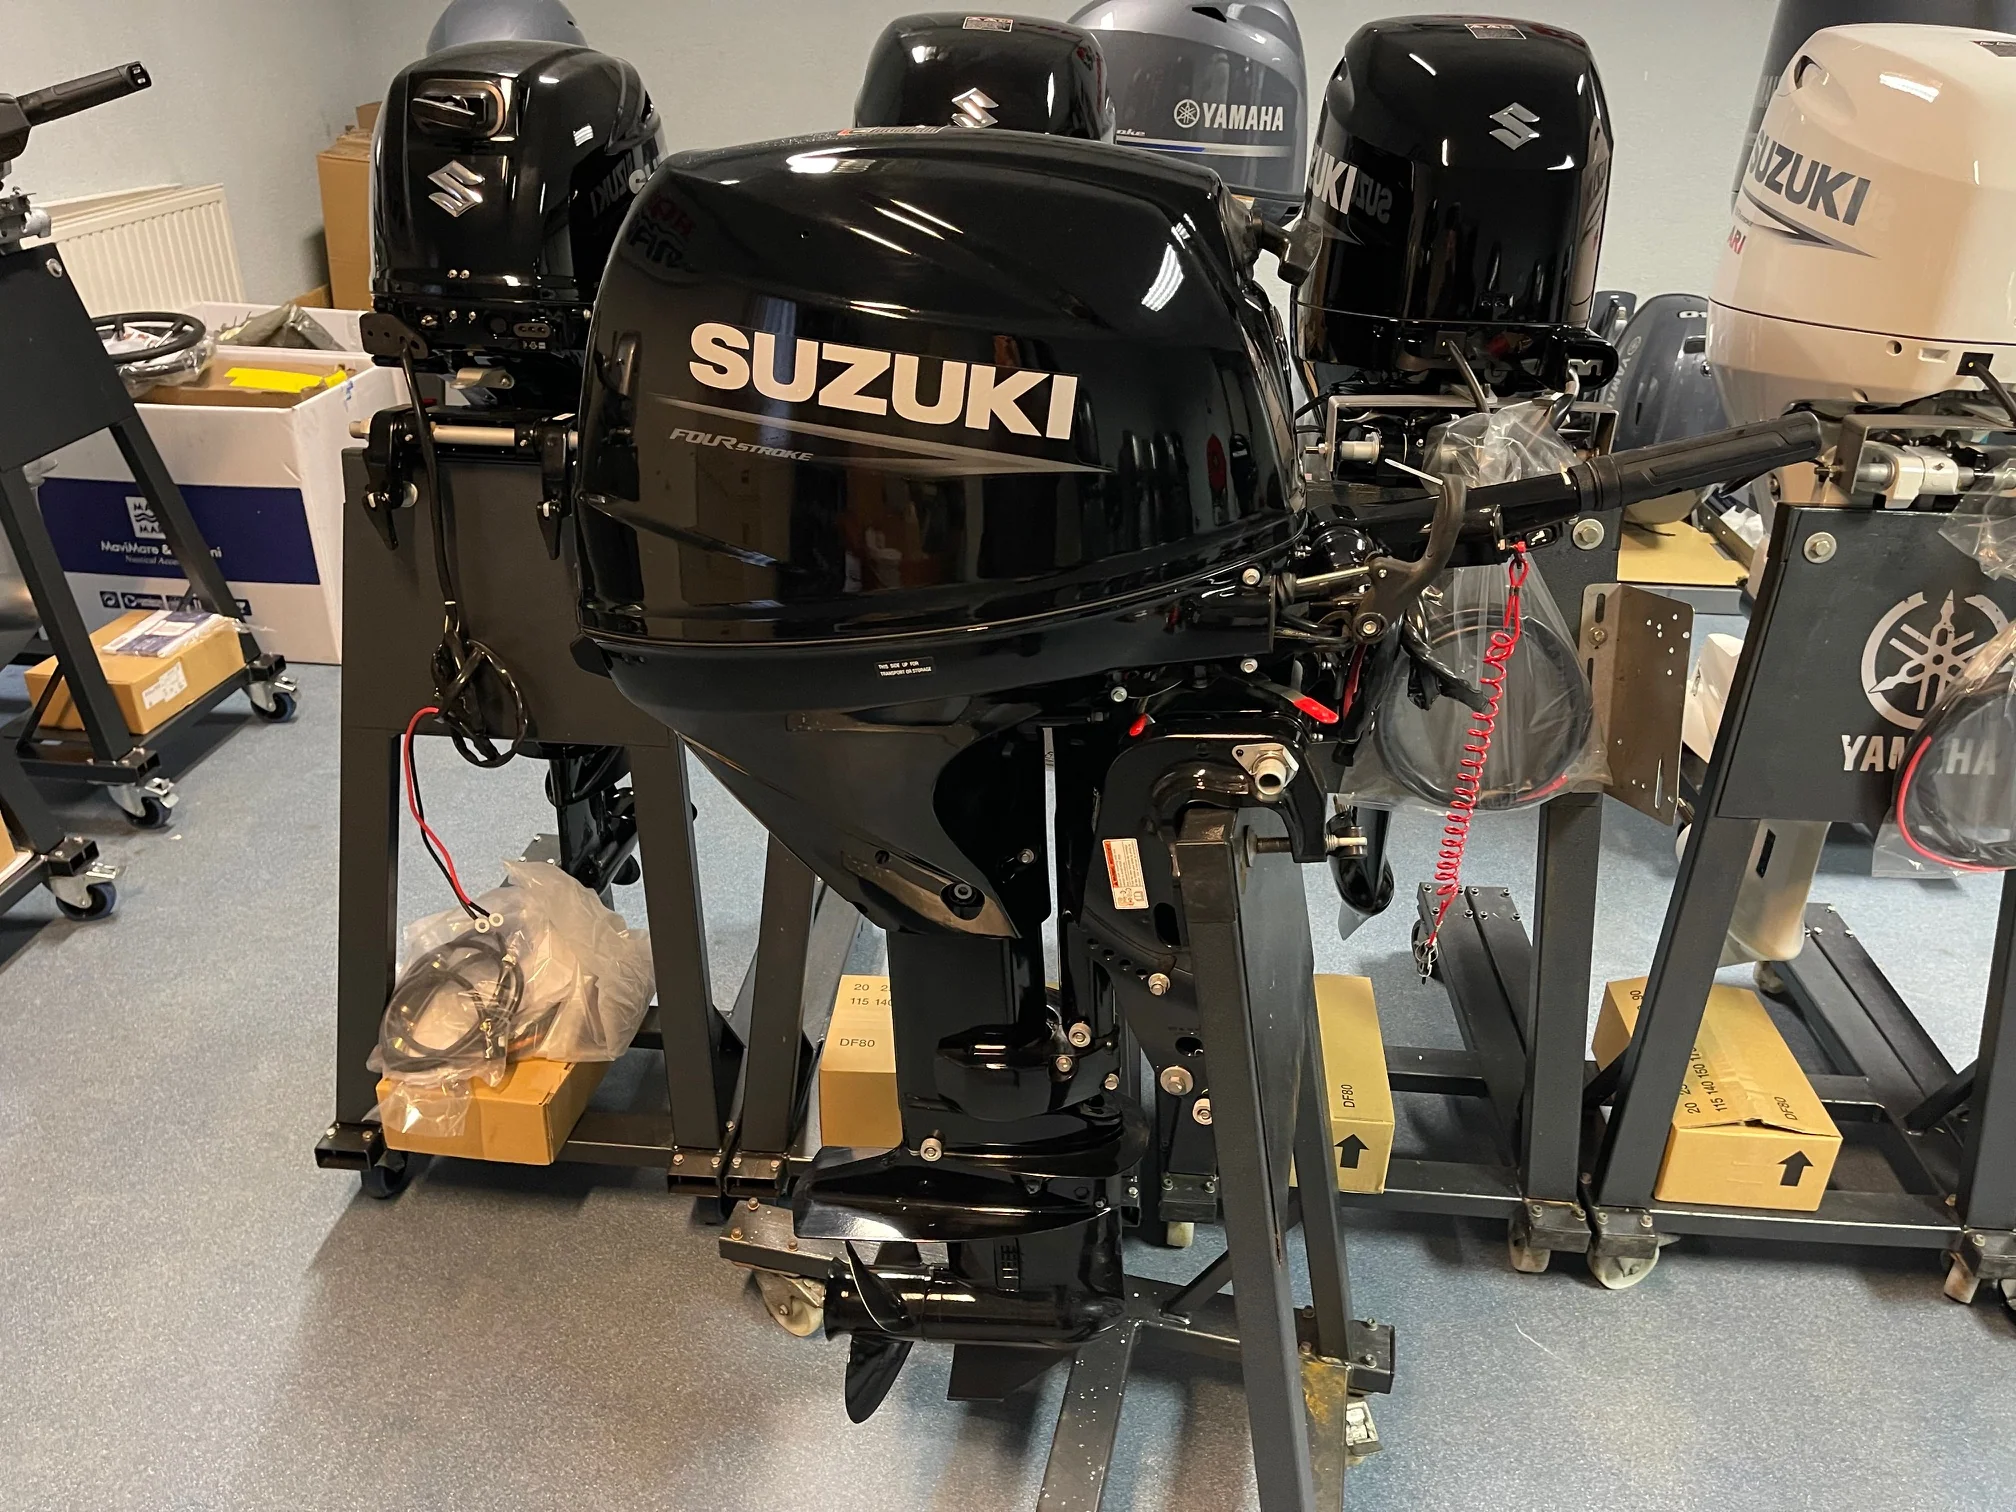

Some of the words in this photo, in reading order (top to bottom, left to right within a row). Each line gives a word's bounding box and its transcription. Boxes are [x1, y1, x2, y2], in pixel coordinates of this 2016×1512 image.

[1202, 102, 1284, 131] YAMAHA
[1749, 129, 1871, 227] SUZUKI
[689, 322, 1078, 440] SUZUKI
[1841, 735, 1996, 775] YAMHA
[853, 983, 870, 991] 20
[880, 984, 891, 992] 2
[851, 997, 869, 1006] 115
[840, 1038, 875, 1048] DF80
[1693, 1063, 1709, 1078] 150
[1701, 1081, 1718, 1094] 140
[1341, 1084, 1355, 1108] DF80
[1685, 1102, 1701, 1114] 20
[1710, 1097, 1727, 1111] 115
[1774, 1096, 1798, 1120] DF80
